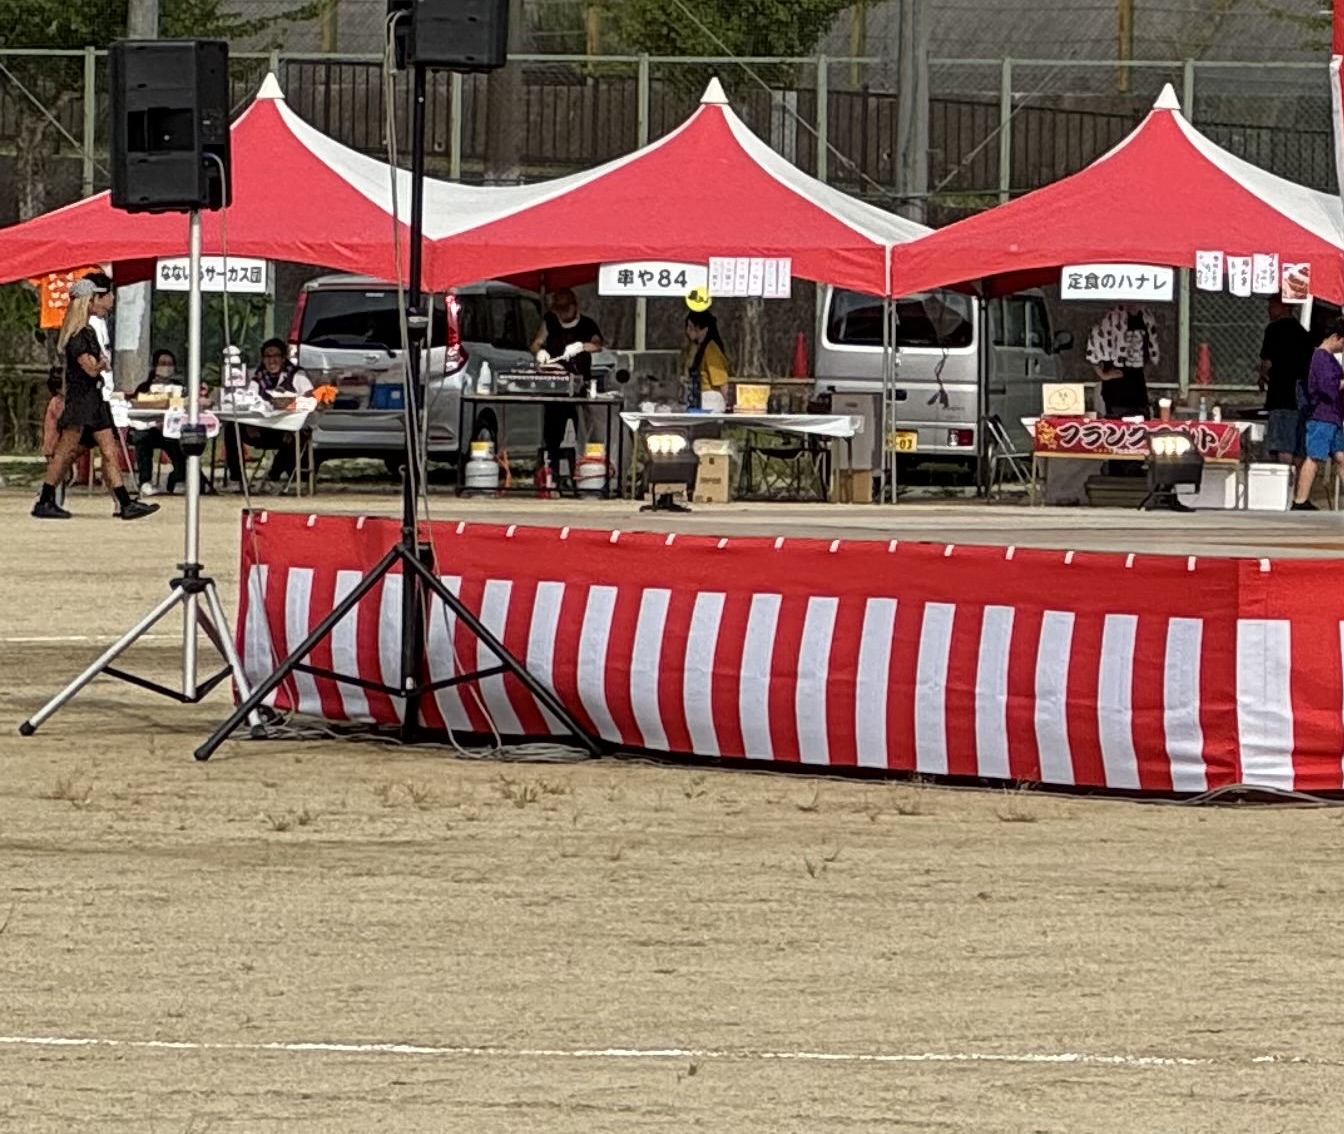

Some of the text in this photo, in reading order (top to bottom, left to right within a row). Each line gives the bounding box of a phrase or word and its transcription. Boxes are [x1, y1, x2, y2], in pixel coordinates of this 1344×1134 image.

[617, 269, 688, 287] 串や84
[1067, 273, 1168, 290] 定食のハナレ
